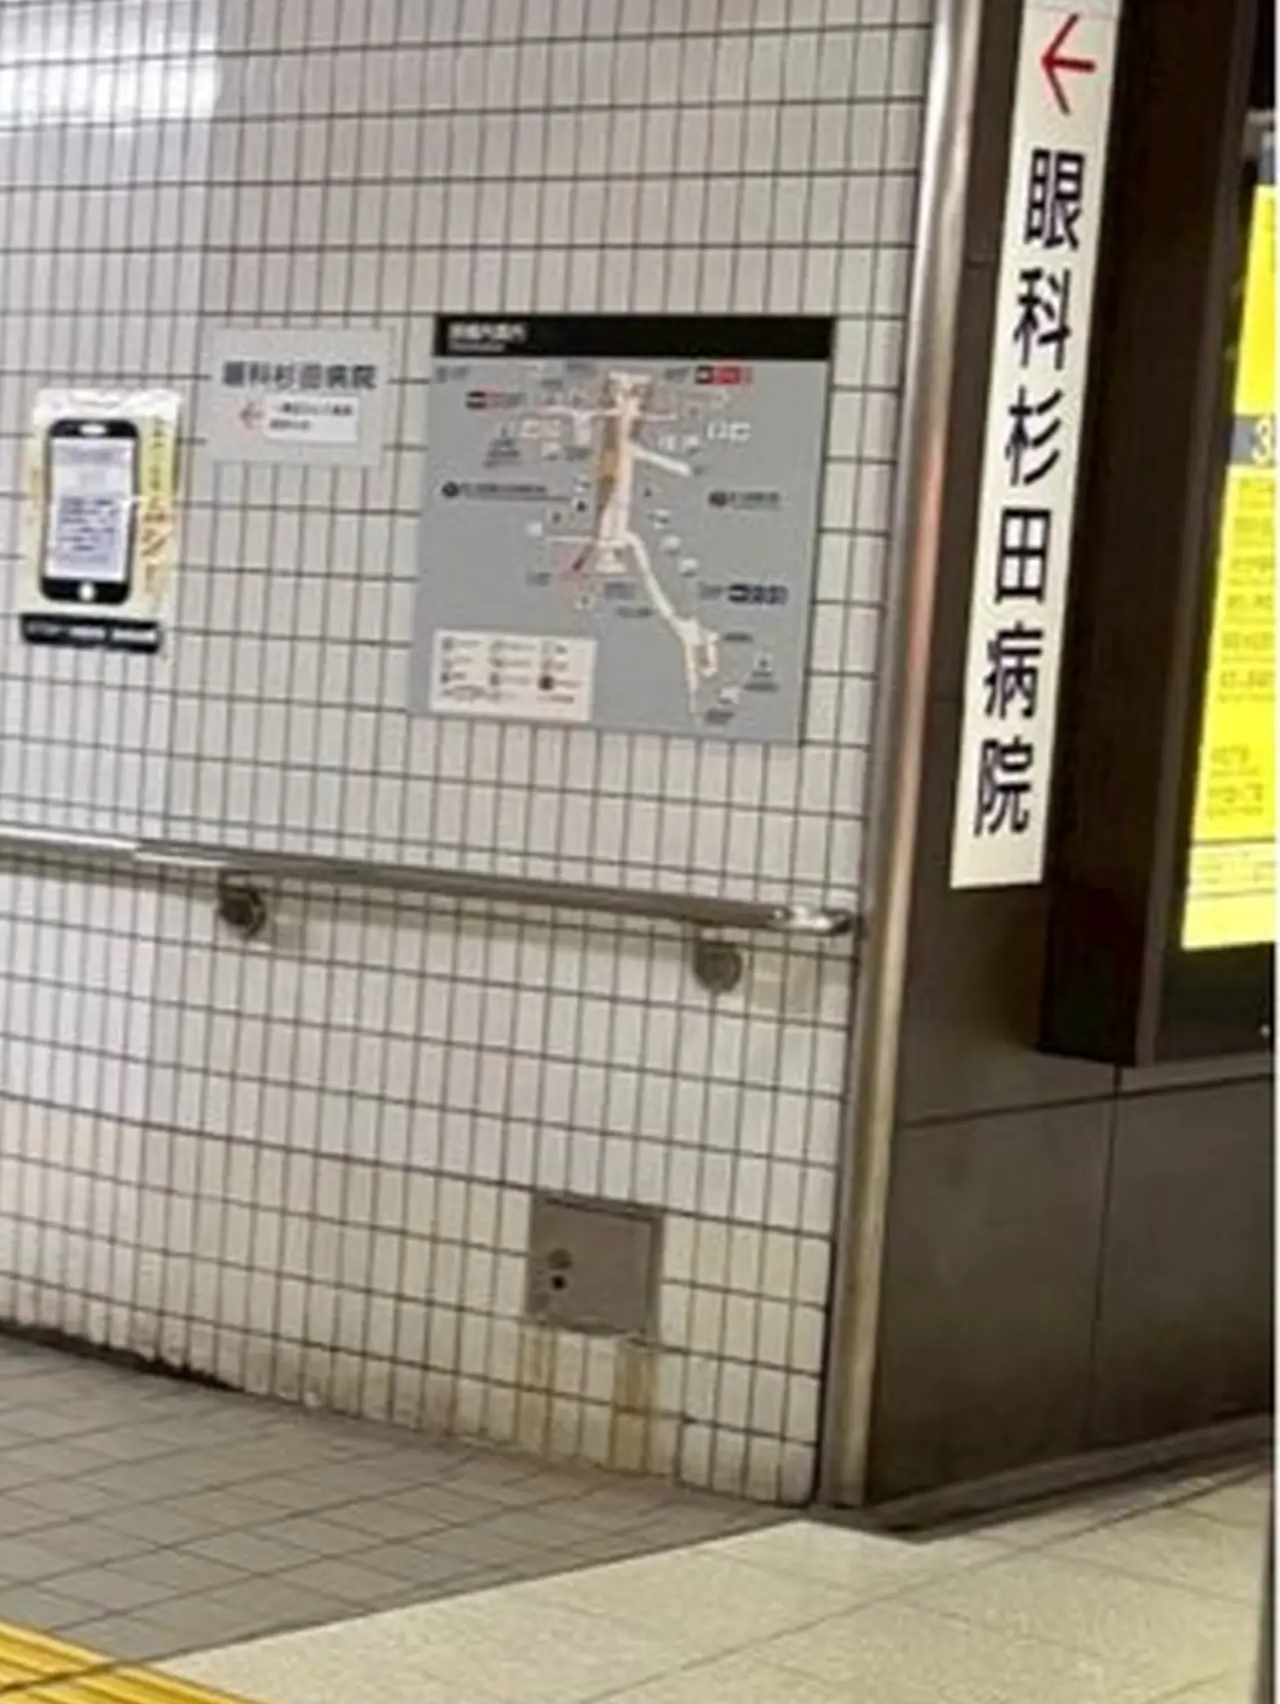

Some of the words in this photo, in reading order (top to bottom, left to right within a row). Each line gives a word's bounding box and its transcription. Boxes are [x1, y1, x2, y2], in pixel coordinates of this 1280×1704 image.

[972, 149, 1086, 836] 眼科杉田病院
